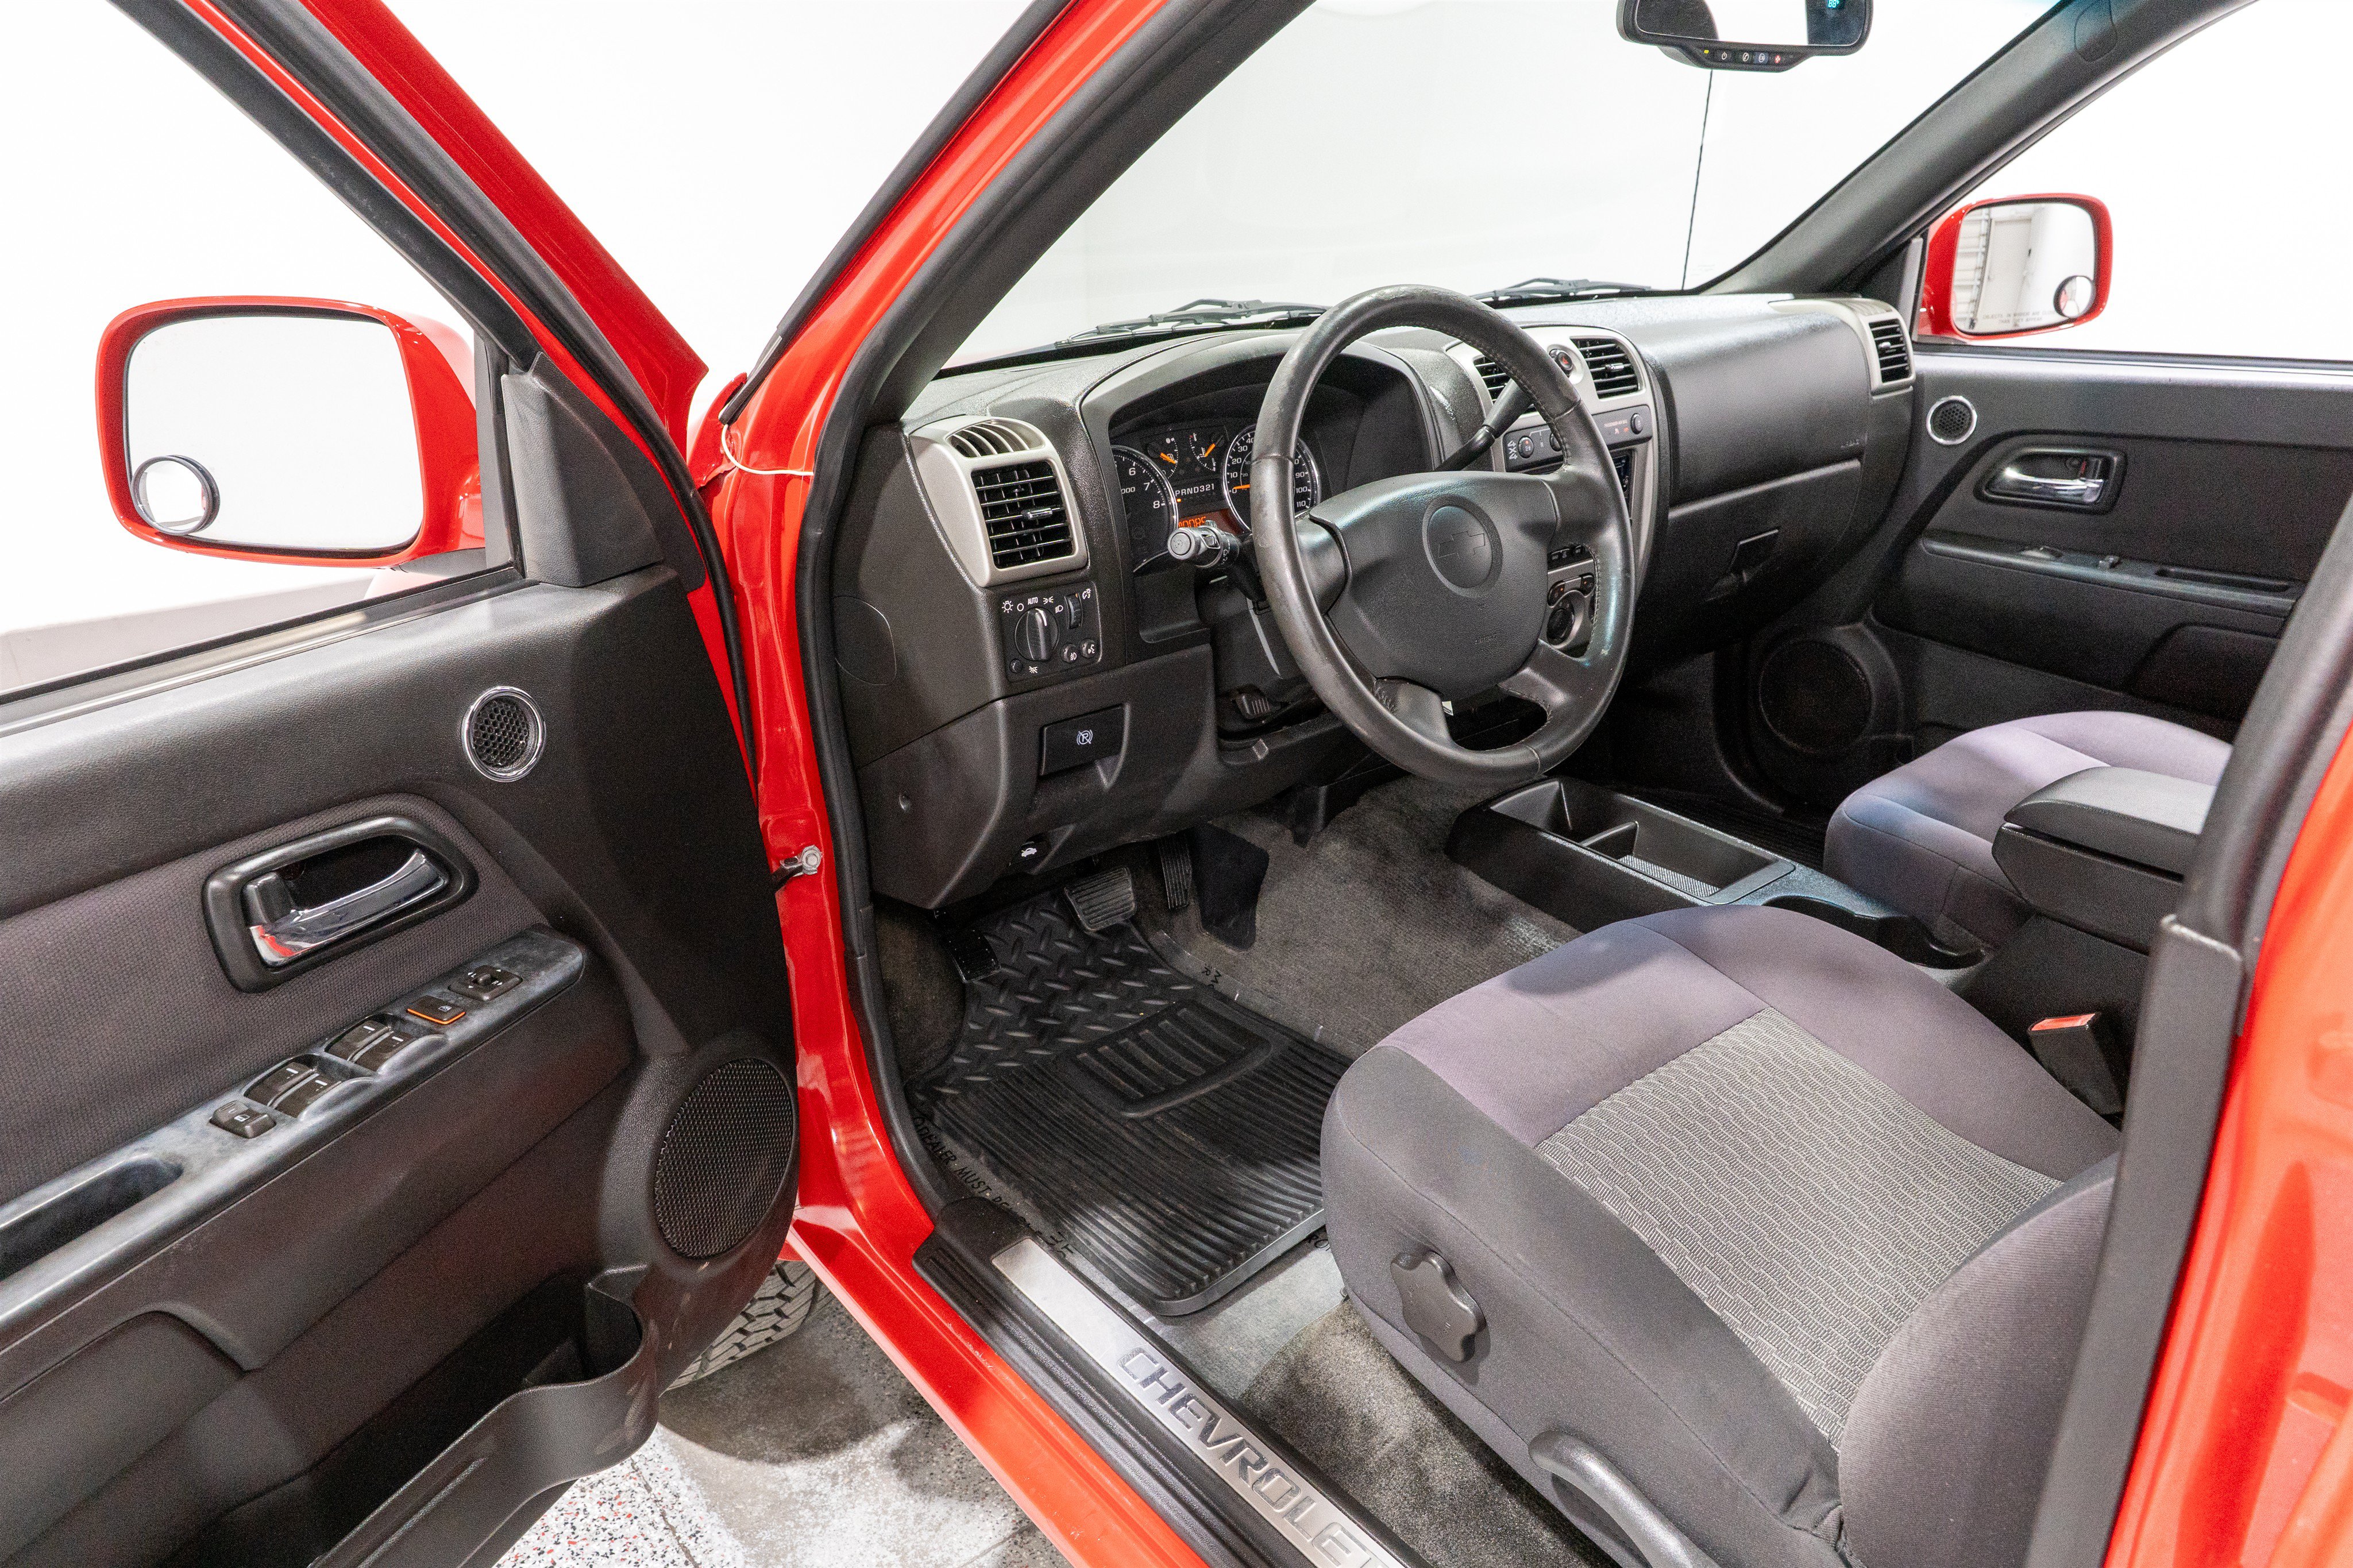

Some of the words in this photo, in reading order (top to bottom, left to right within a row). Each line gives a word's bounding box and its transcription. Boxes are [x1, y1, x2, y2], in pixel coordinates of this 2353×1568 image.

[1128, 467, 1136, 476] 6
[1143, 482, 1150, 491] 7
[1175, 483, 1214, 497] PRND321
[1153, 500, 1160, 509] 8
[1028, 597, 1038, 605] AUTO
[954, 1166, 993, 1195] MUST
[1116, 1346, 1389, 1568] CHEVROLE
